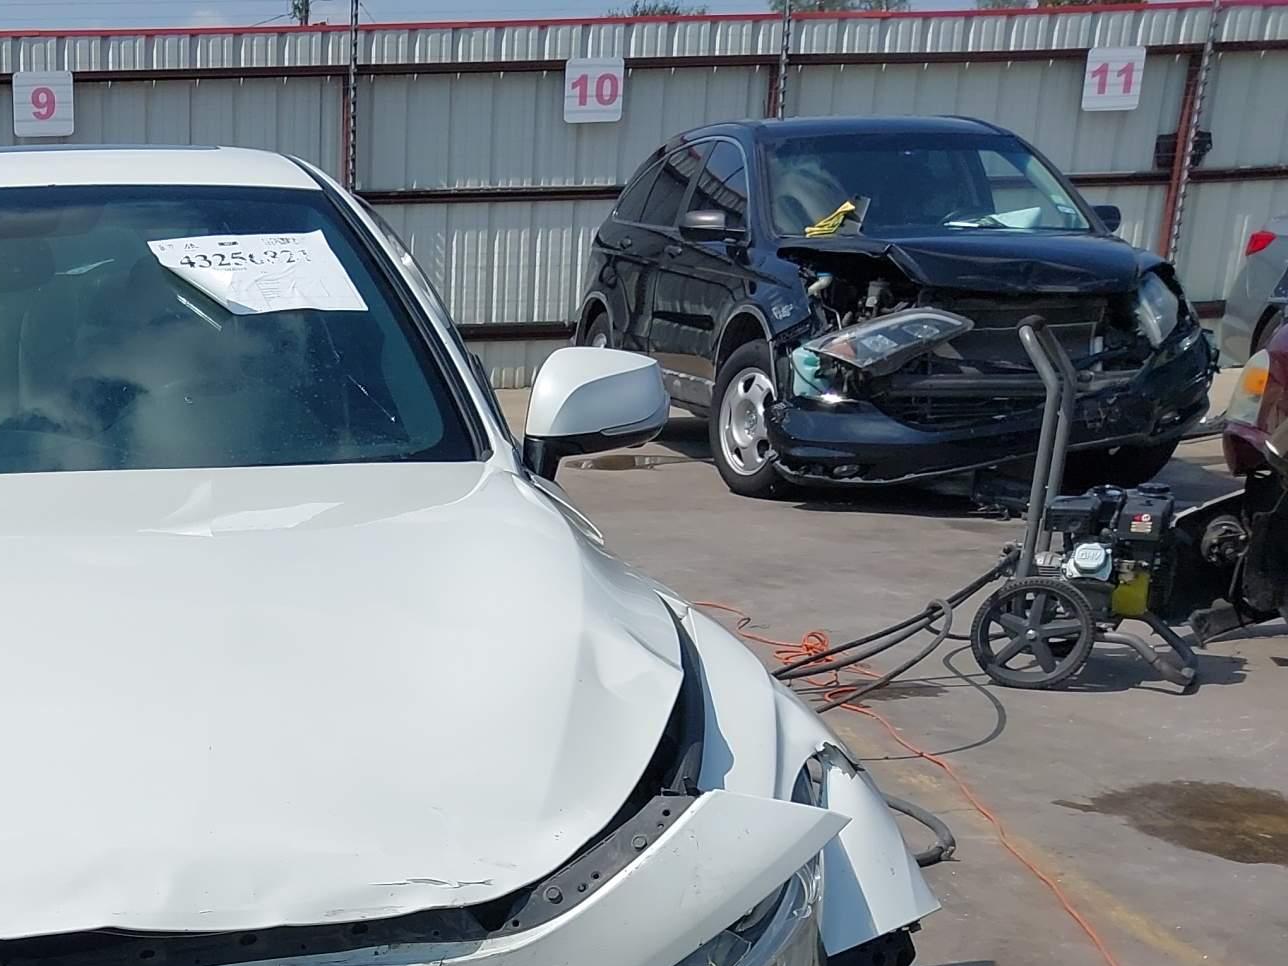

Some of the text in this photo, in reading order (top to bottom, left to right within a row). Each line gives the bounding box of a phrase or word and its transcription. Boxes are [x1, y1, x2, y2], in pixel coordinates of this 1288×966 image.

[571, 73, 619, 106] 10
[1091, 61, 1136, 95] 11
[31, 87, 56, 121] 9
